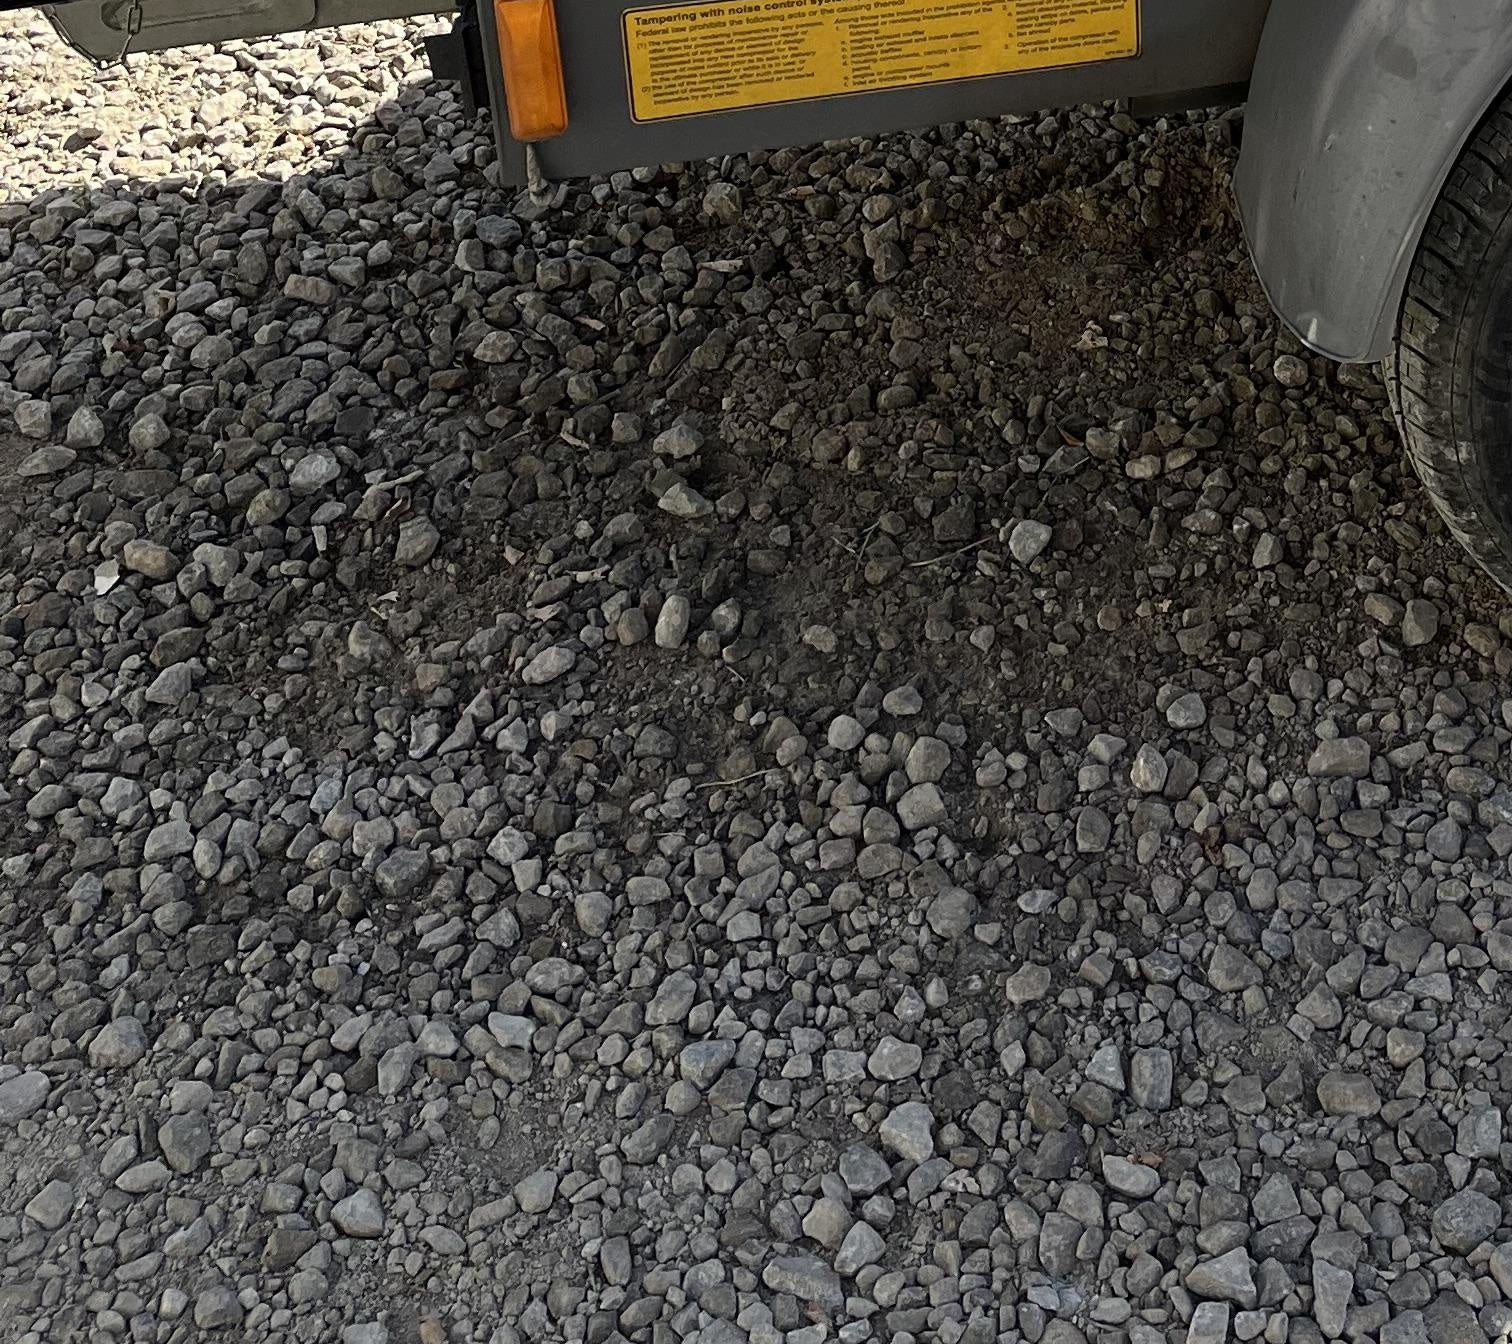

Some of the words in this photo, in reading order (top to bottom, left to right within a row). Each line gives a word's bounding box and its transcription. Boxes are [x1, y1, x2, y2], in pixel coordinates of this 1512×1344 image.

[633, 12, 696, 25] Tampering
[699, 7, 724, 18] with
[728, 4, 760, 15] noise
[635, 27, 669, 37] Federal
[688, 20, 726, 32] prohibits
[745, 14, 785, 24] following
[836, 3, 871, 13] causing
